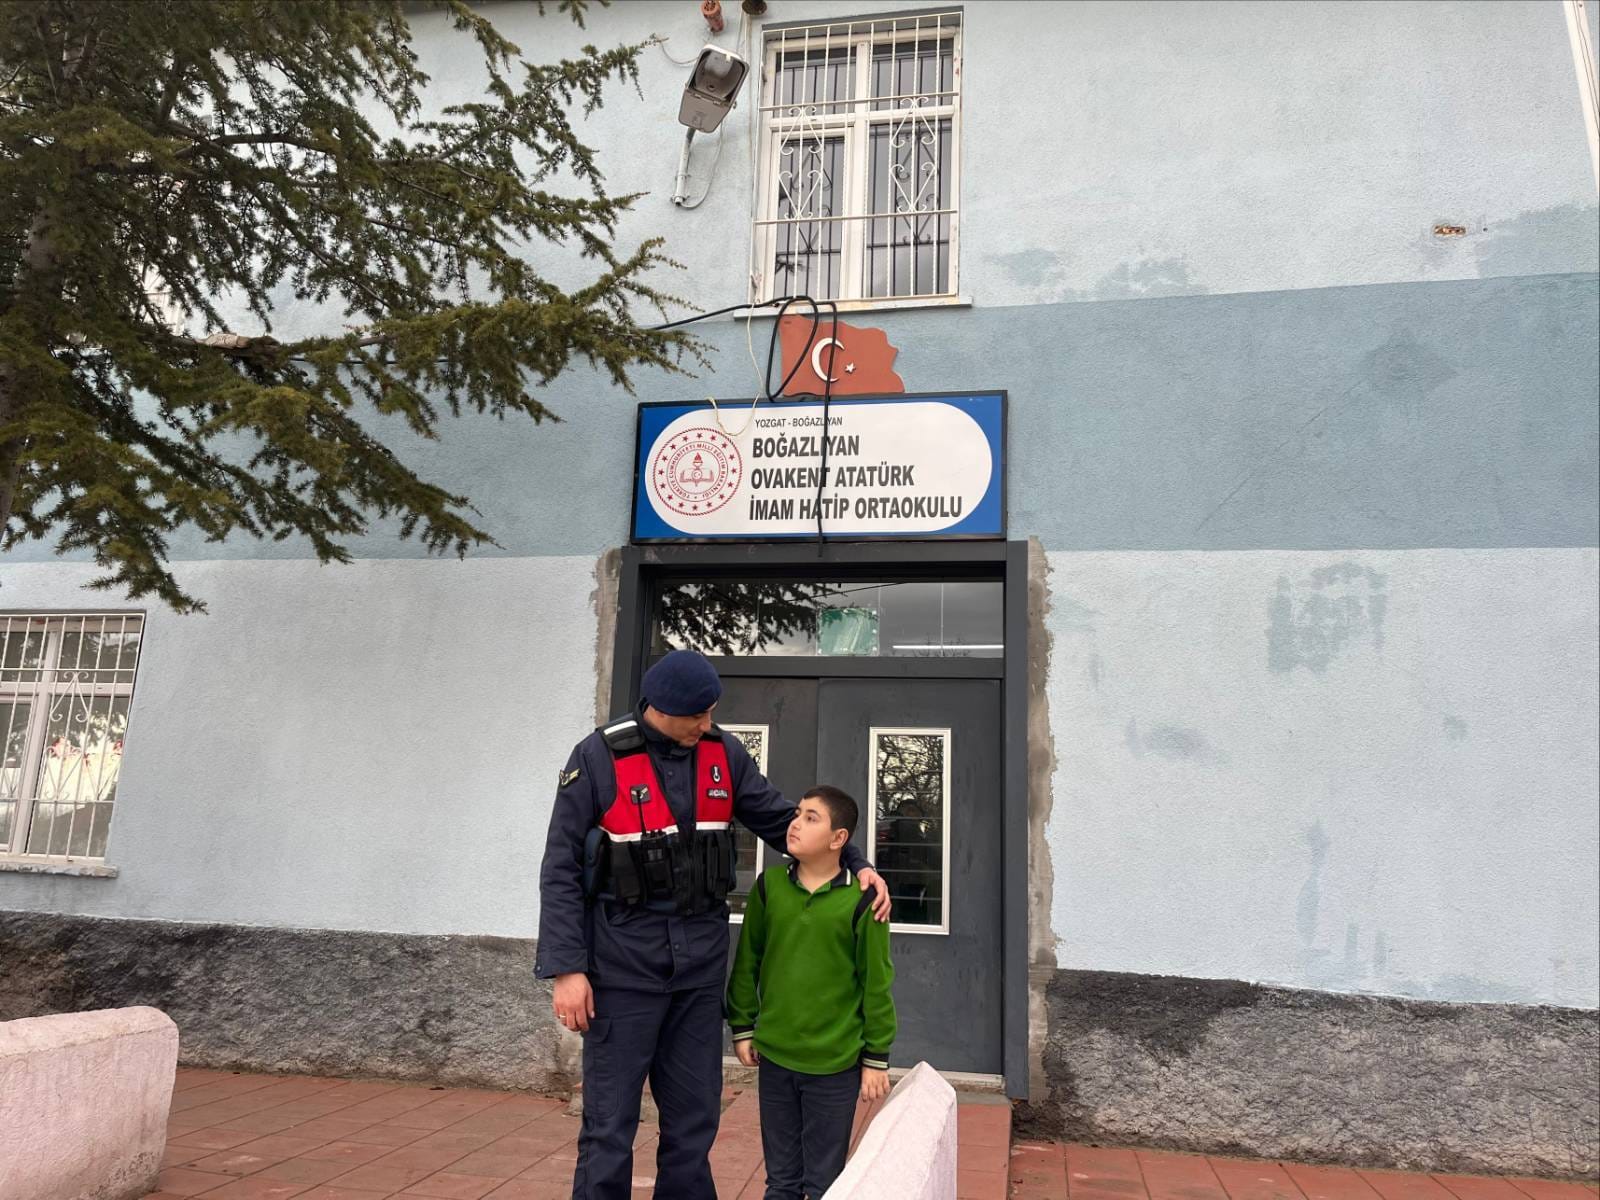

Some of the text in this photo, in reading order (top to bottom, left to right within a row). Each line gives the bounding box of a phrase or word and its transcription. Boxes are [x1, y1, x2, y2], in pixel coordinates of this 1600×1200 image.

[755, 418, 786, 429] YOZGAT
[792, 416, 843, 427] BOĞAZLYAN
[751, 461, 915, 490] OVAKENT ATATÜRK
[749, 492, 962, 521] İMAM HATİP ORTAOKULU
